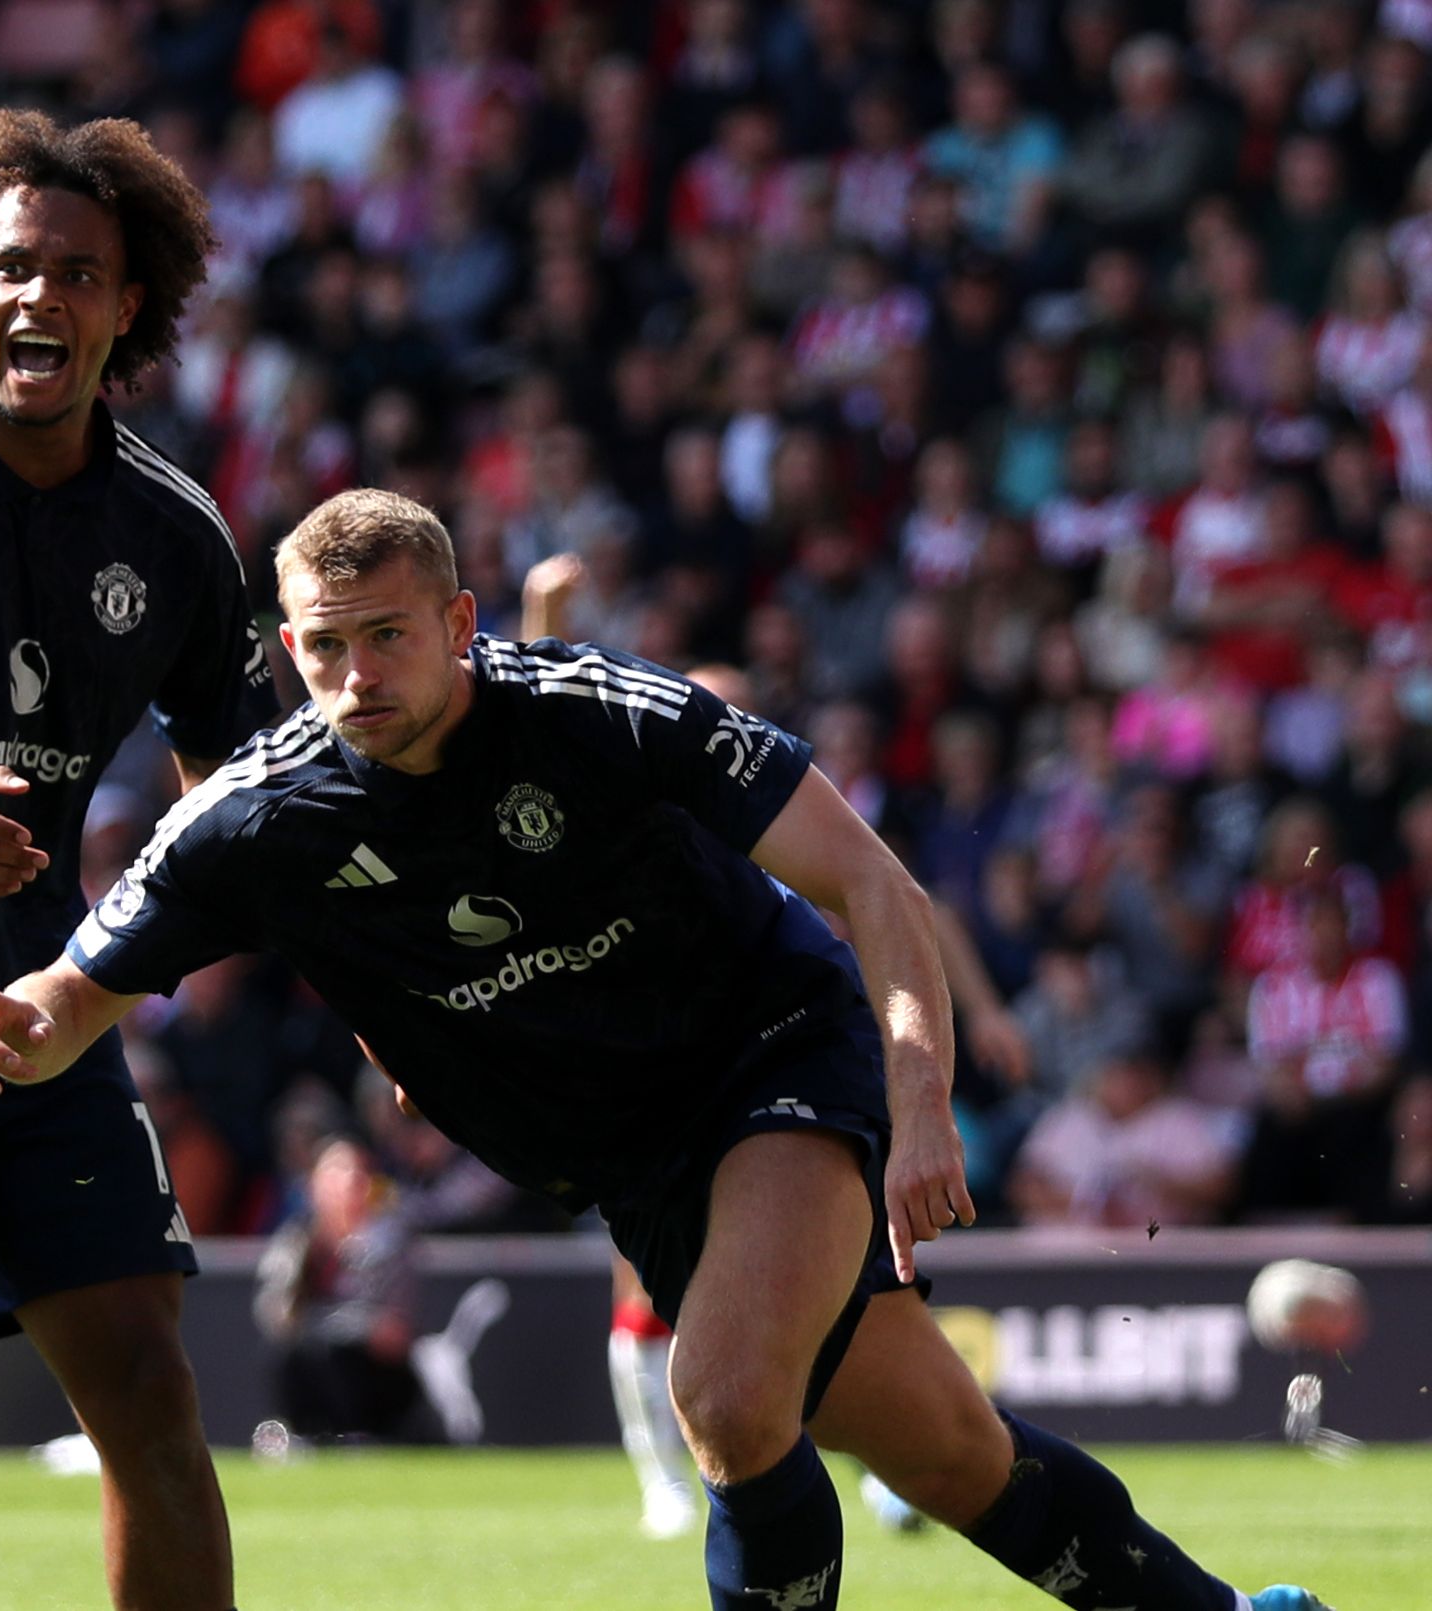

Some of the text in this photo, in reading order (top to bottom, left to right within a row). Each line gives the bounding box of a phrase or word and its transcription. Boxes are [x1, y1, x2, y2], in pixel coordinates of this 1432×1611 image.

[248, 665, 272, 688] TEC
[739, 730, 778, 788] TECHNO
[413, 917, 636, 1013] apdragon
[932, 1304, 1248, 1407] OLLBIT
